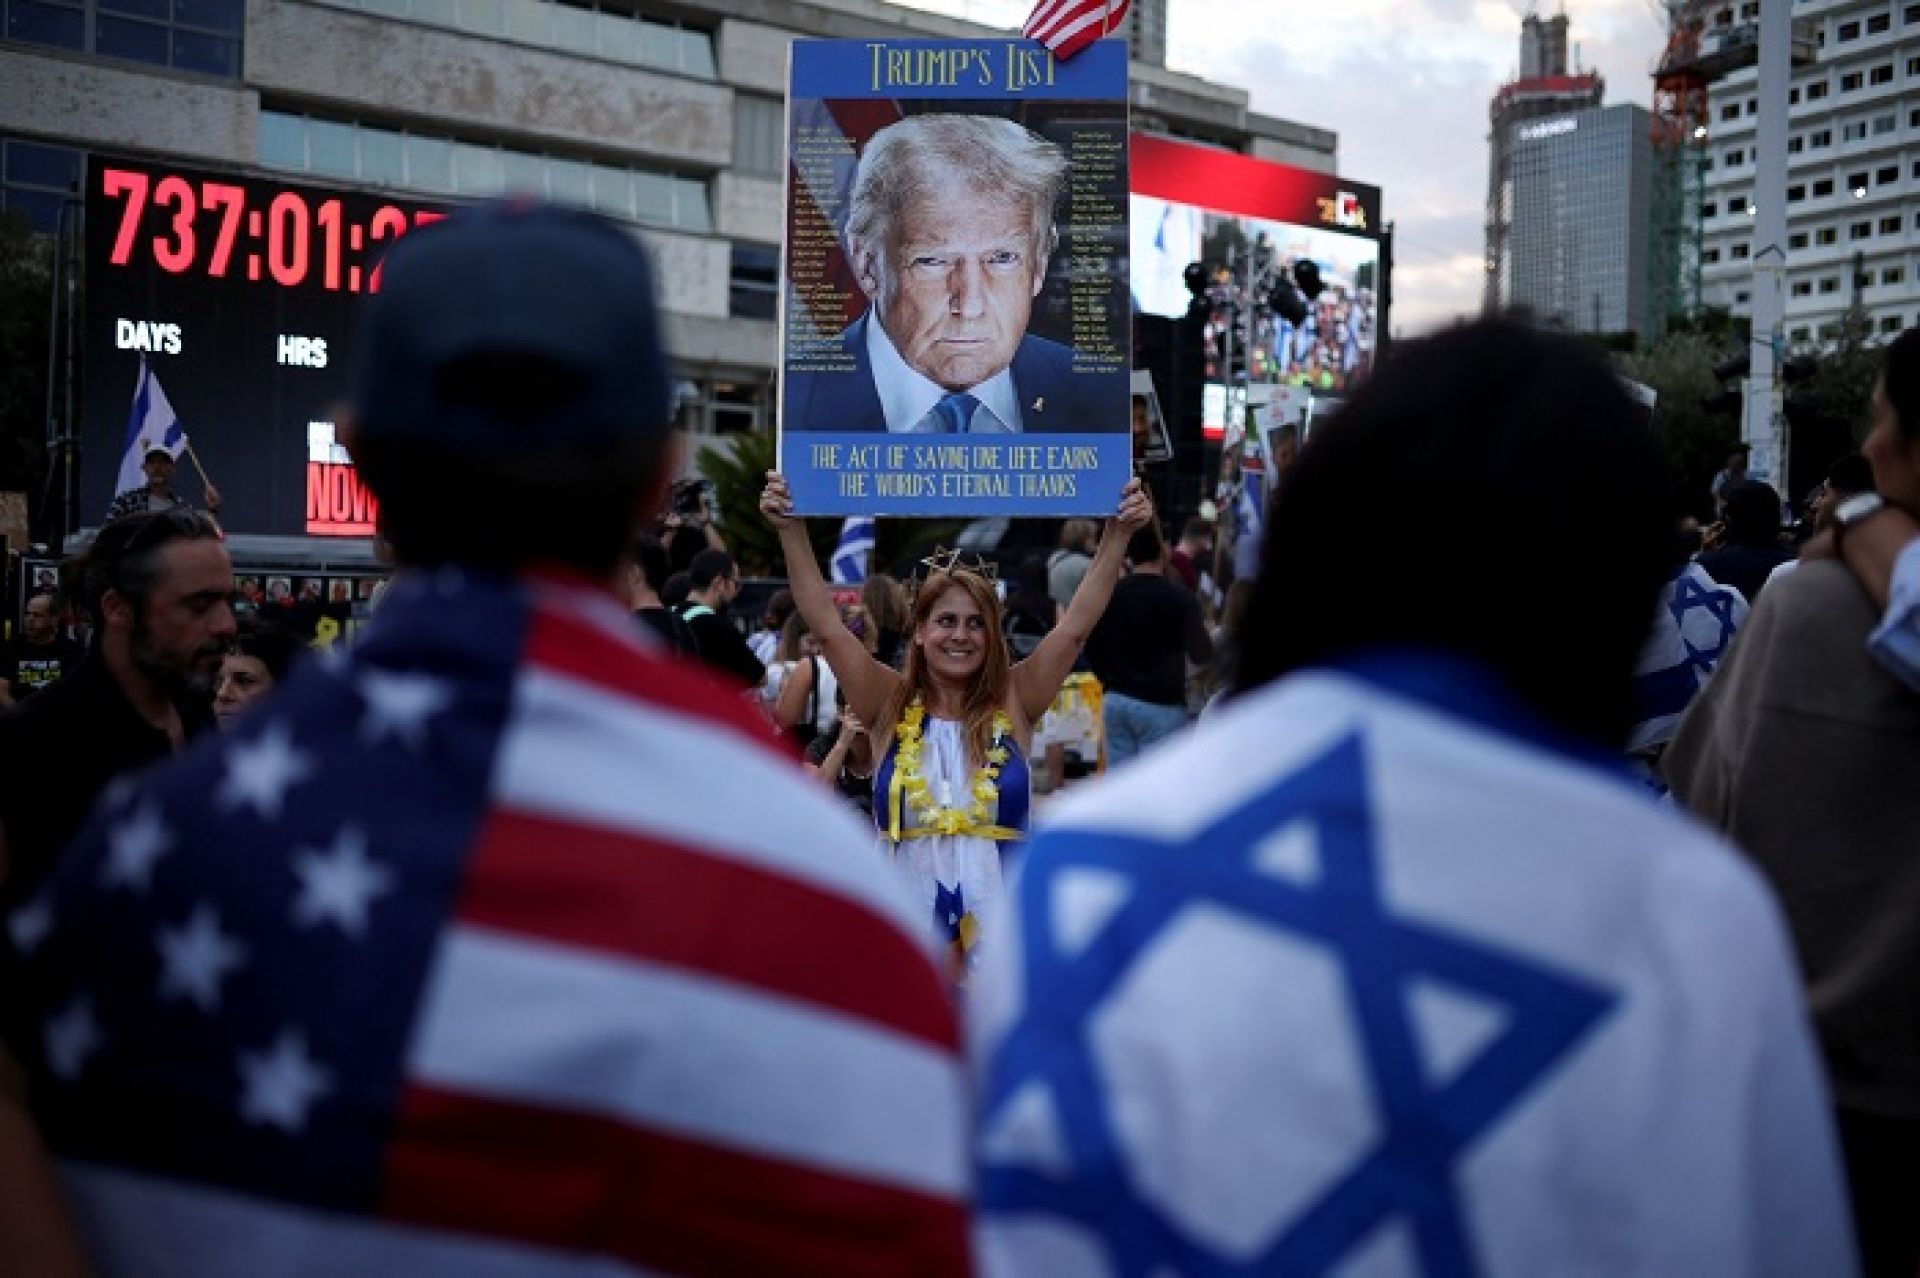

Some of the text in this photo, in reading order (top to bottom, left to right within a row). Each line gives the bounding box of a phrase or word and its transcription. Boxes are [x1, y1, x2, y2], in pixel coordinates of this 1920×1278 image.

[1006, 43, 1055, 91] LIST
[116, 318, 328, 369] DAYS HRS
[811, 444, 842, 470] THE
[847, 444, 880, 470] ACT
[886, 444, 909, 470] OF
[973, 446, 1003, 470] ONE
[1008, 446, 1043, 470] LIFE
[1047, 446, 1098, 470] EARNS
[838, 473, 1076, 497] THE WORLD'S ETERNAL THANKS
